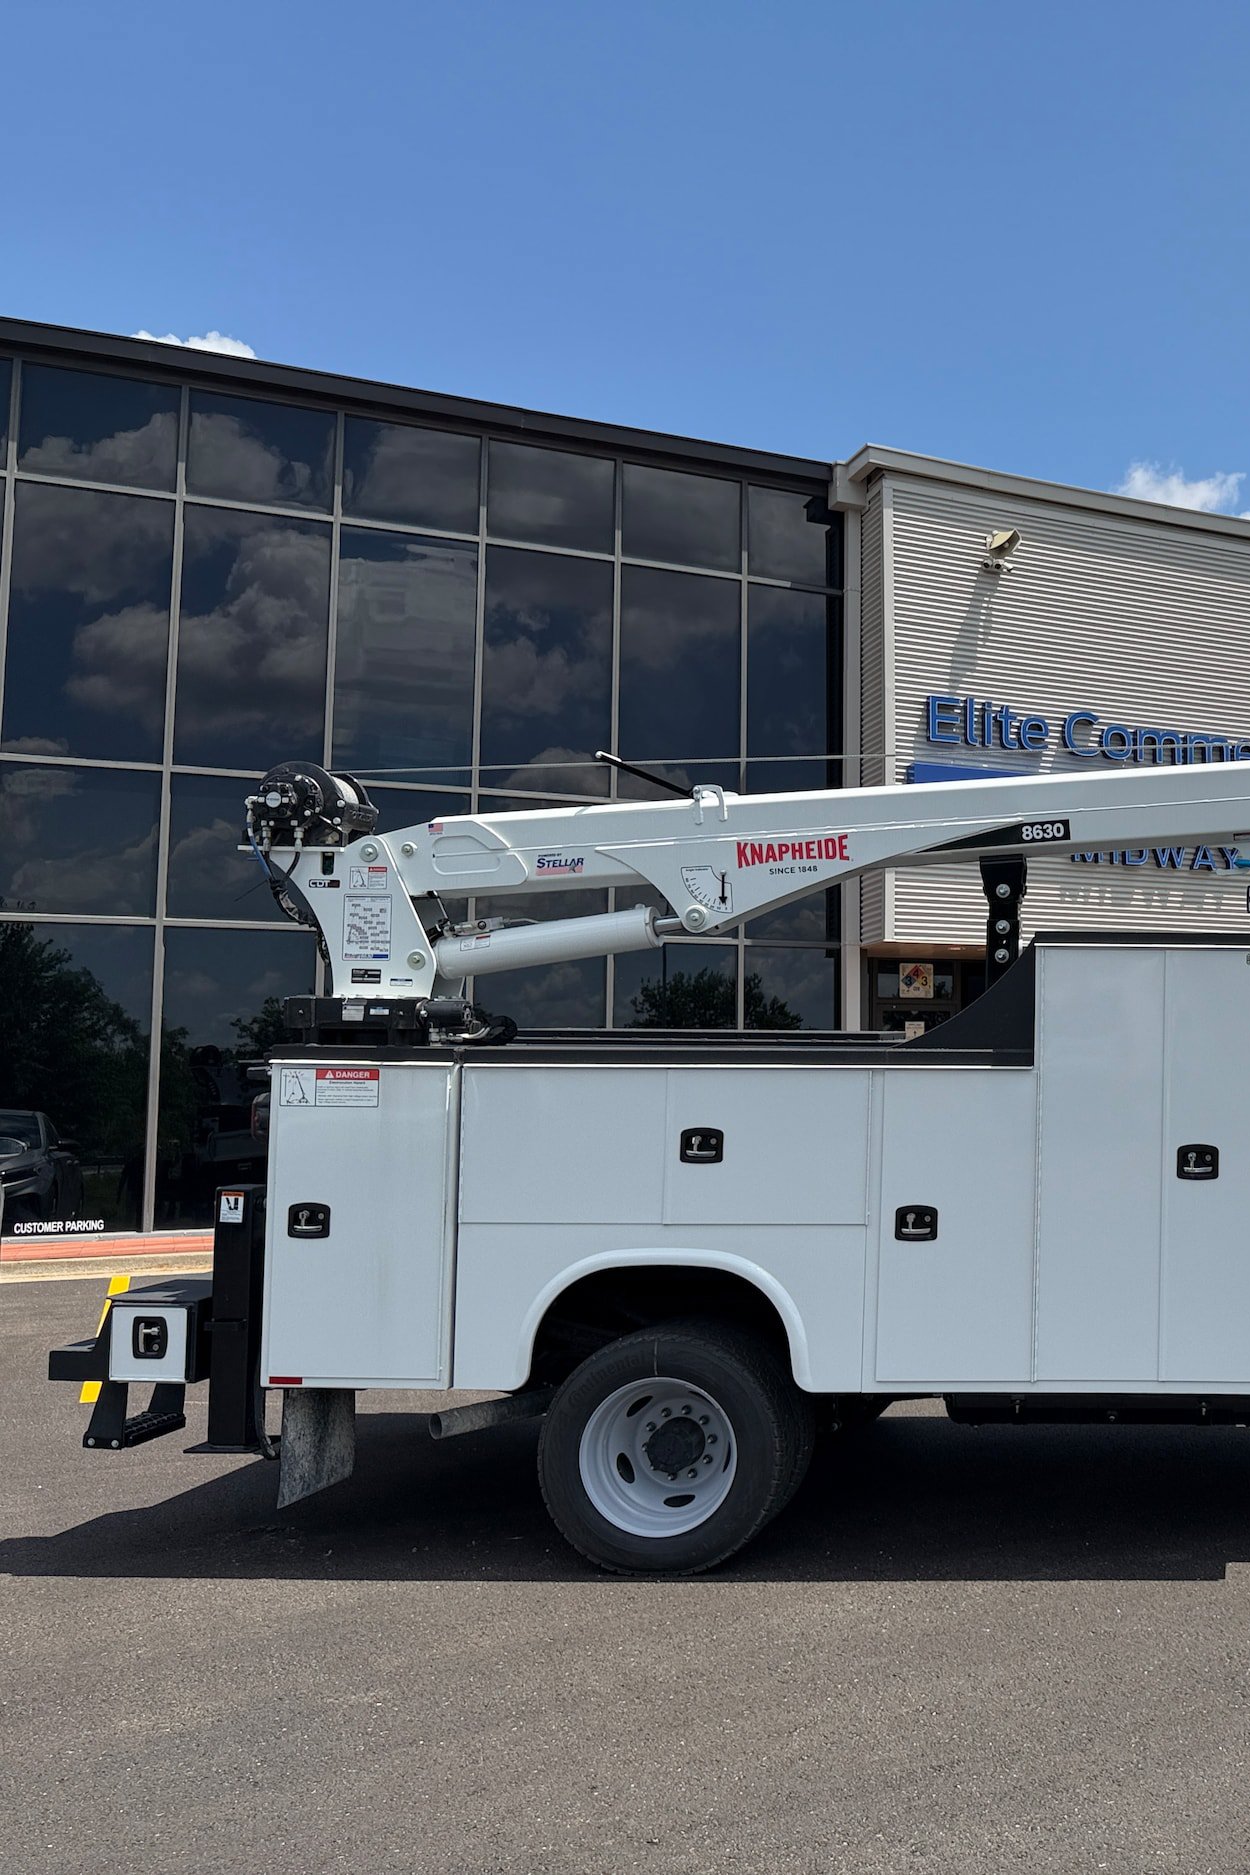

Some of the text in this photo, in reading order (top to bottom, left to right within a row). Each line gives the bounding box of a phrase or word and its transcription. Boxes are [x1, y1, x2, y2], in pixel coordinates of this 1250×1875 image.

[927, 695, 1050, 751] Elite
[1022, 822, 1065, 840] 8630
[736, 835, 850, 868] KNAPHEIDE
[536, 857, 584, 869] STELLAR
[769, 865, 818, 875] SINCE 1848
[921, 976, 928, 986] 3
[335, 1071, 370, 1079] DANGER
[14, 1220, 104, 1233] CUSTOMER PARKING
